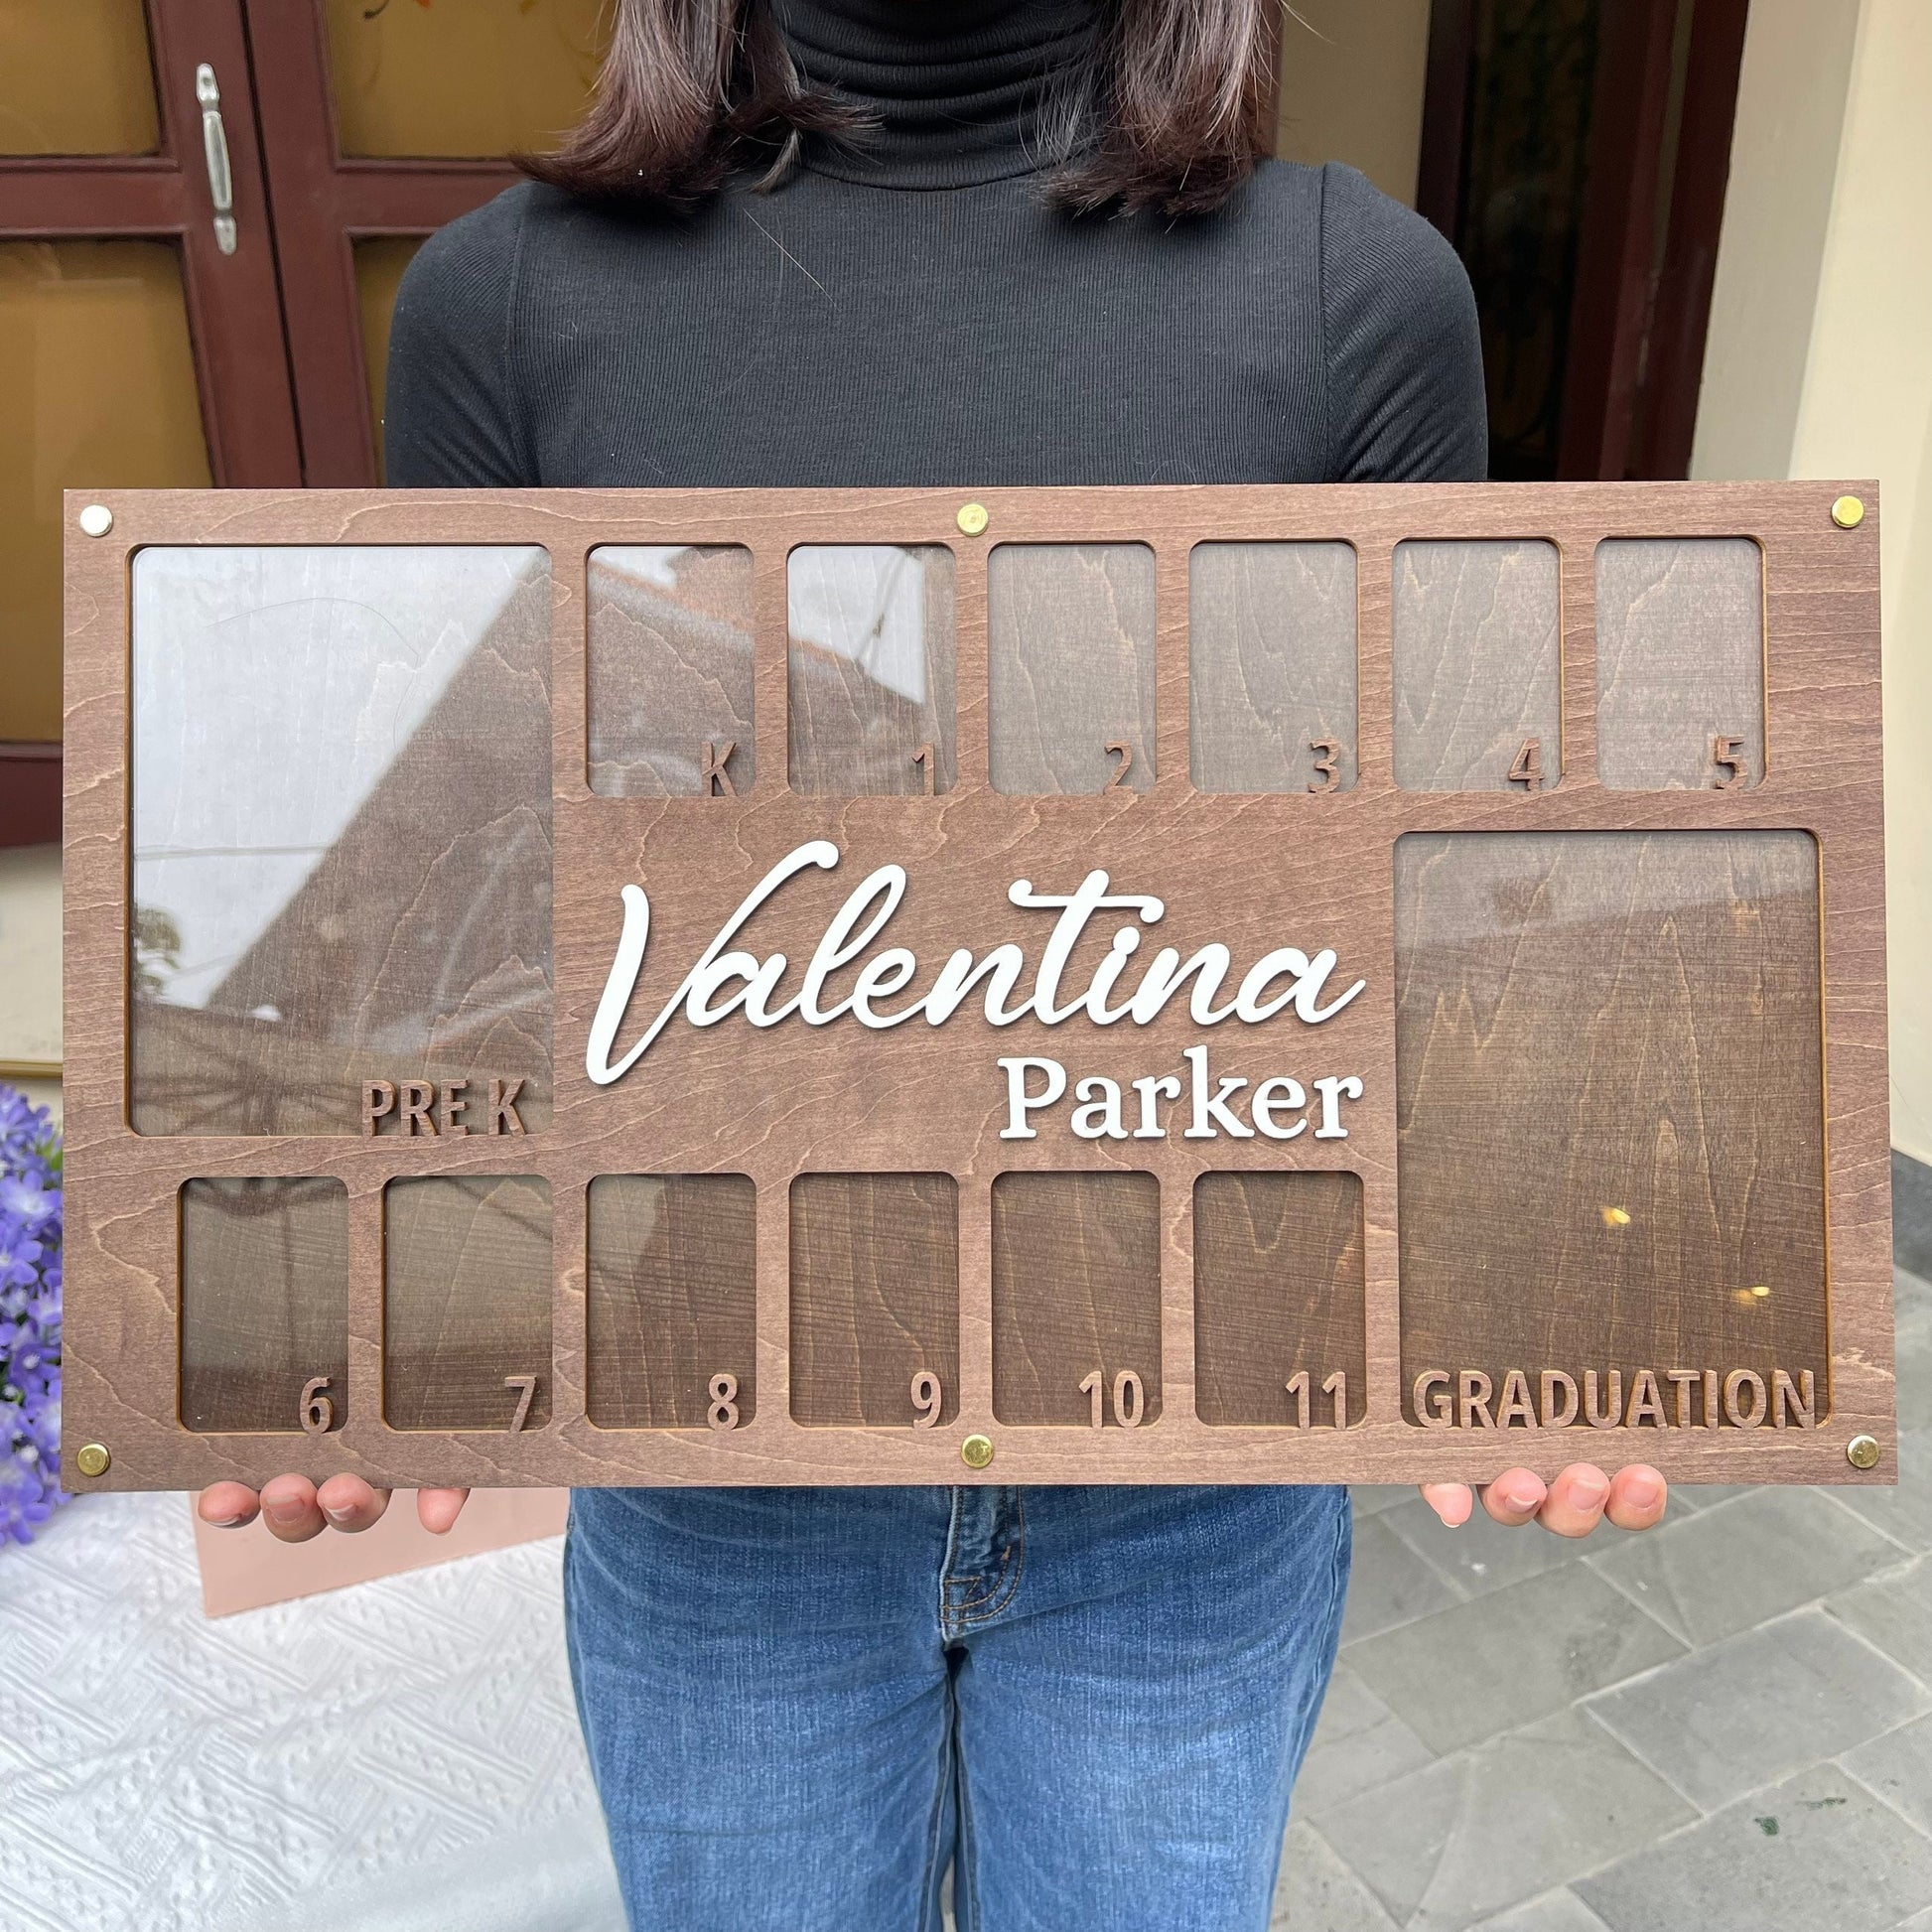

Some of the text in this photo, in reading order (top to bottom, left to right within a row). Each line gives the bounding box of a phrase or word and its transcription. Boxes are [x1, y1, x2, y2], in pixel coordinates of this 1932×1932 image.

[702, 741, 738, 796] K
[910, 742, 936, 796] 1
[1103, 740, 1135, 795] 2
[1307, 738, 1341, 794] 3
[1507, 737, 1545, 791] 4
[1714, 735, 1749, 790] 5
[585, 839, 1367, 1085] Valentina
[361, 1078, 527, 1137] PRE K
[996, 1043, 1364, 1141] Parker
[299, 1375, 335, 1435] 6
[503, 1374, 538, 1434] 7
[706, 1372, 742, 1432] 8
[909, 1370, 943, 1430] 9
[1078, 1369, 1145, 1430] 10
[1284, 1369, 1348, 1431] 11
[1412, 1368, 1817, 1431] GRADUATION
